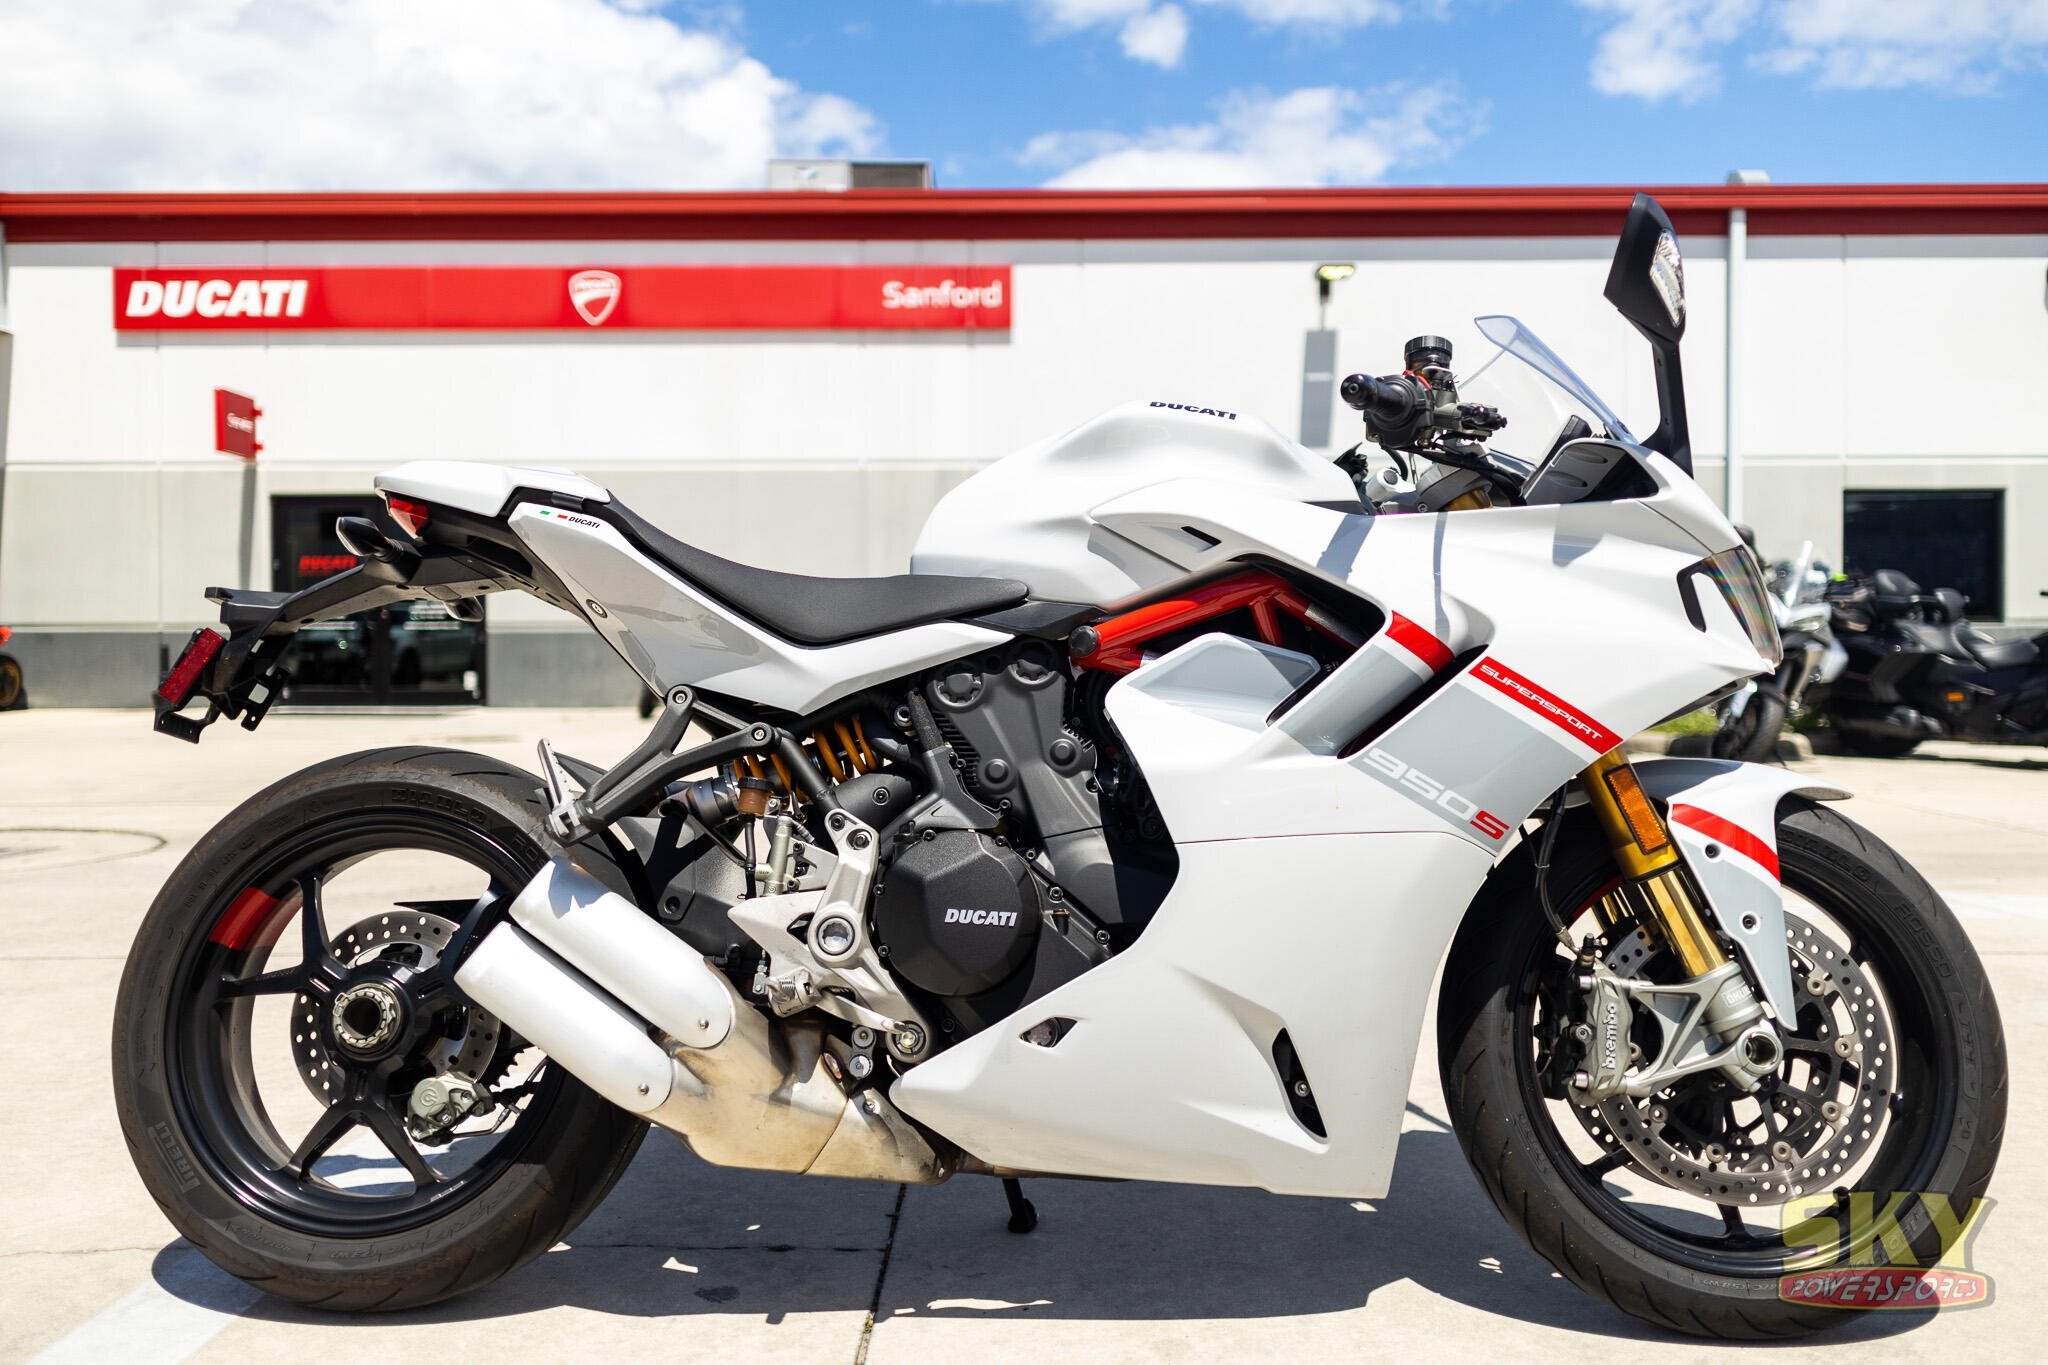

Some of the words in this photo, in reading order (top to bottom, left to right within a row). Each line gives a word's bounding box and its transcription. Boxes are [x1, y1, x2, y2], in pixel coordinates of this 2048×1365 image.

[126, 280, 308, 318] DUCATI
[882, 279, 1002, 309] Sanford
[1150, 401, 1237, 420] DUCATI
[568, 516, 601, 529] DUCATI
[1479, 663, 1603, 741] SUPERSPORT
[944, 908, 1018, 927] DUCATI
[1601, 1002, 1618, 1069] brembo
[147, 1120, 201, 1193] PIRELLI
